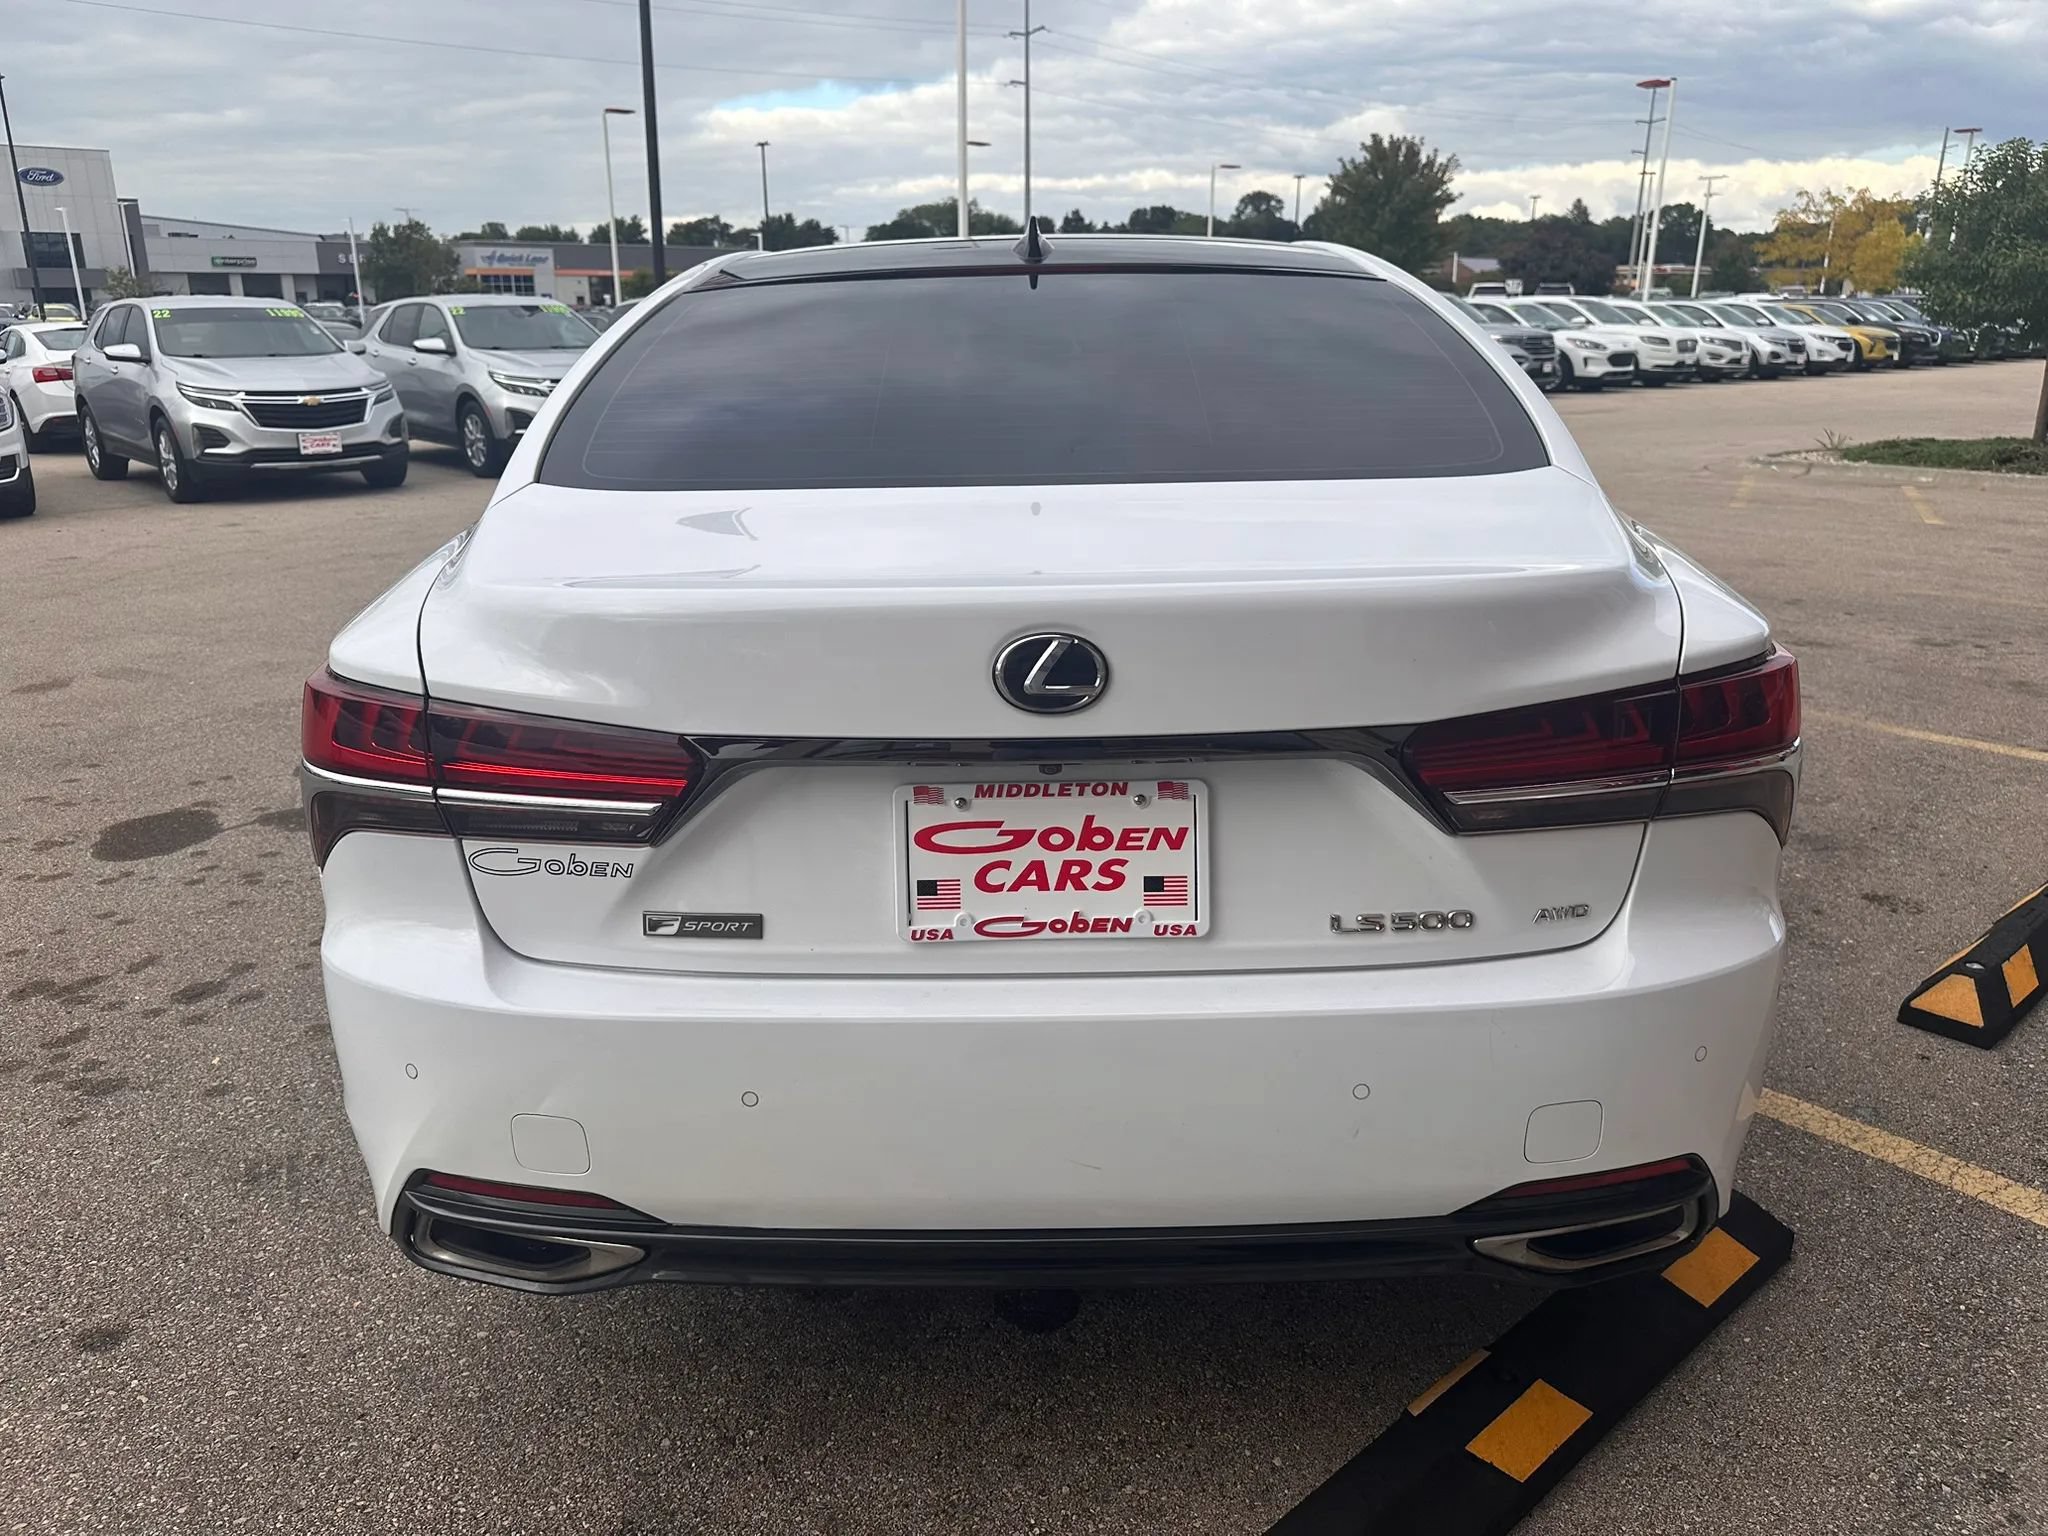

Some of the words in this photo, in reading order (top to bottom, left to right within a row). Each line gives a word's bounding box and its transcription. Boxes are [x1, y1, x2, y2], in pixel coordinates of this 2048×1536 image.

[27, 170, 55, 181] Ford
[152, 309, 171, 318] 22
[974, 782, 1128, 798] MIDDLETON
[973, 858, 1130, 893] CARS
[1531, 903, 1590, 925] AWD
[682, 920, 754, 933] SPORT
[910, 928, 954, 941] USA
[1153, 923, 1198, 937] USA
